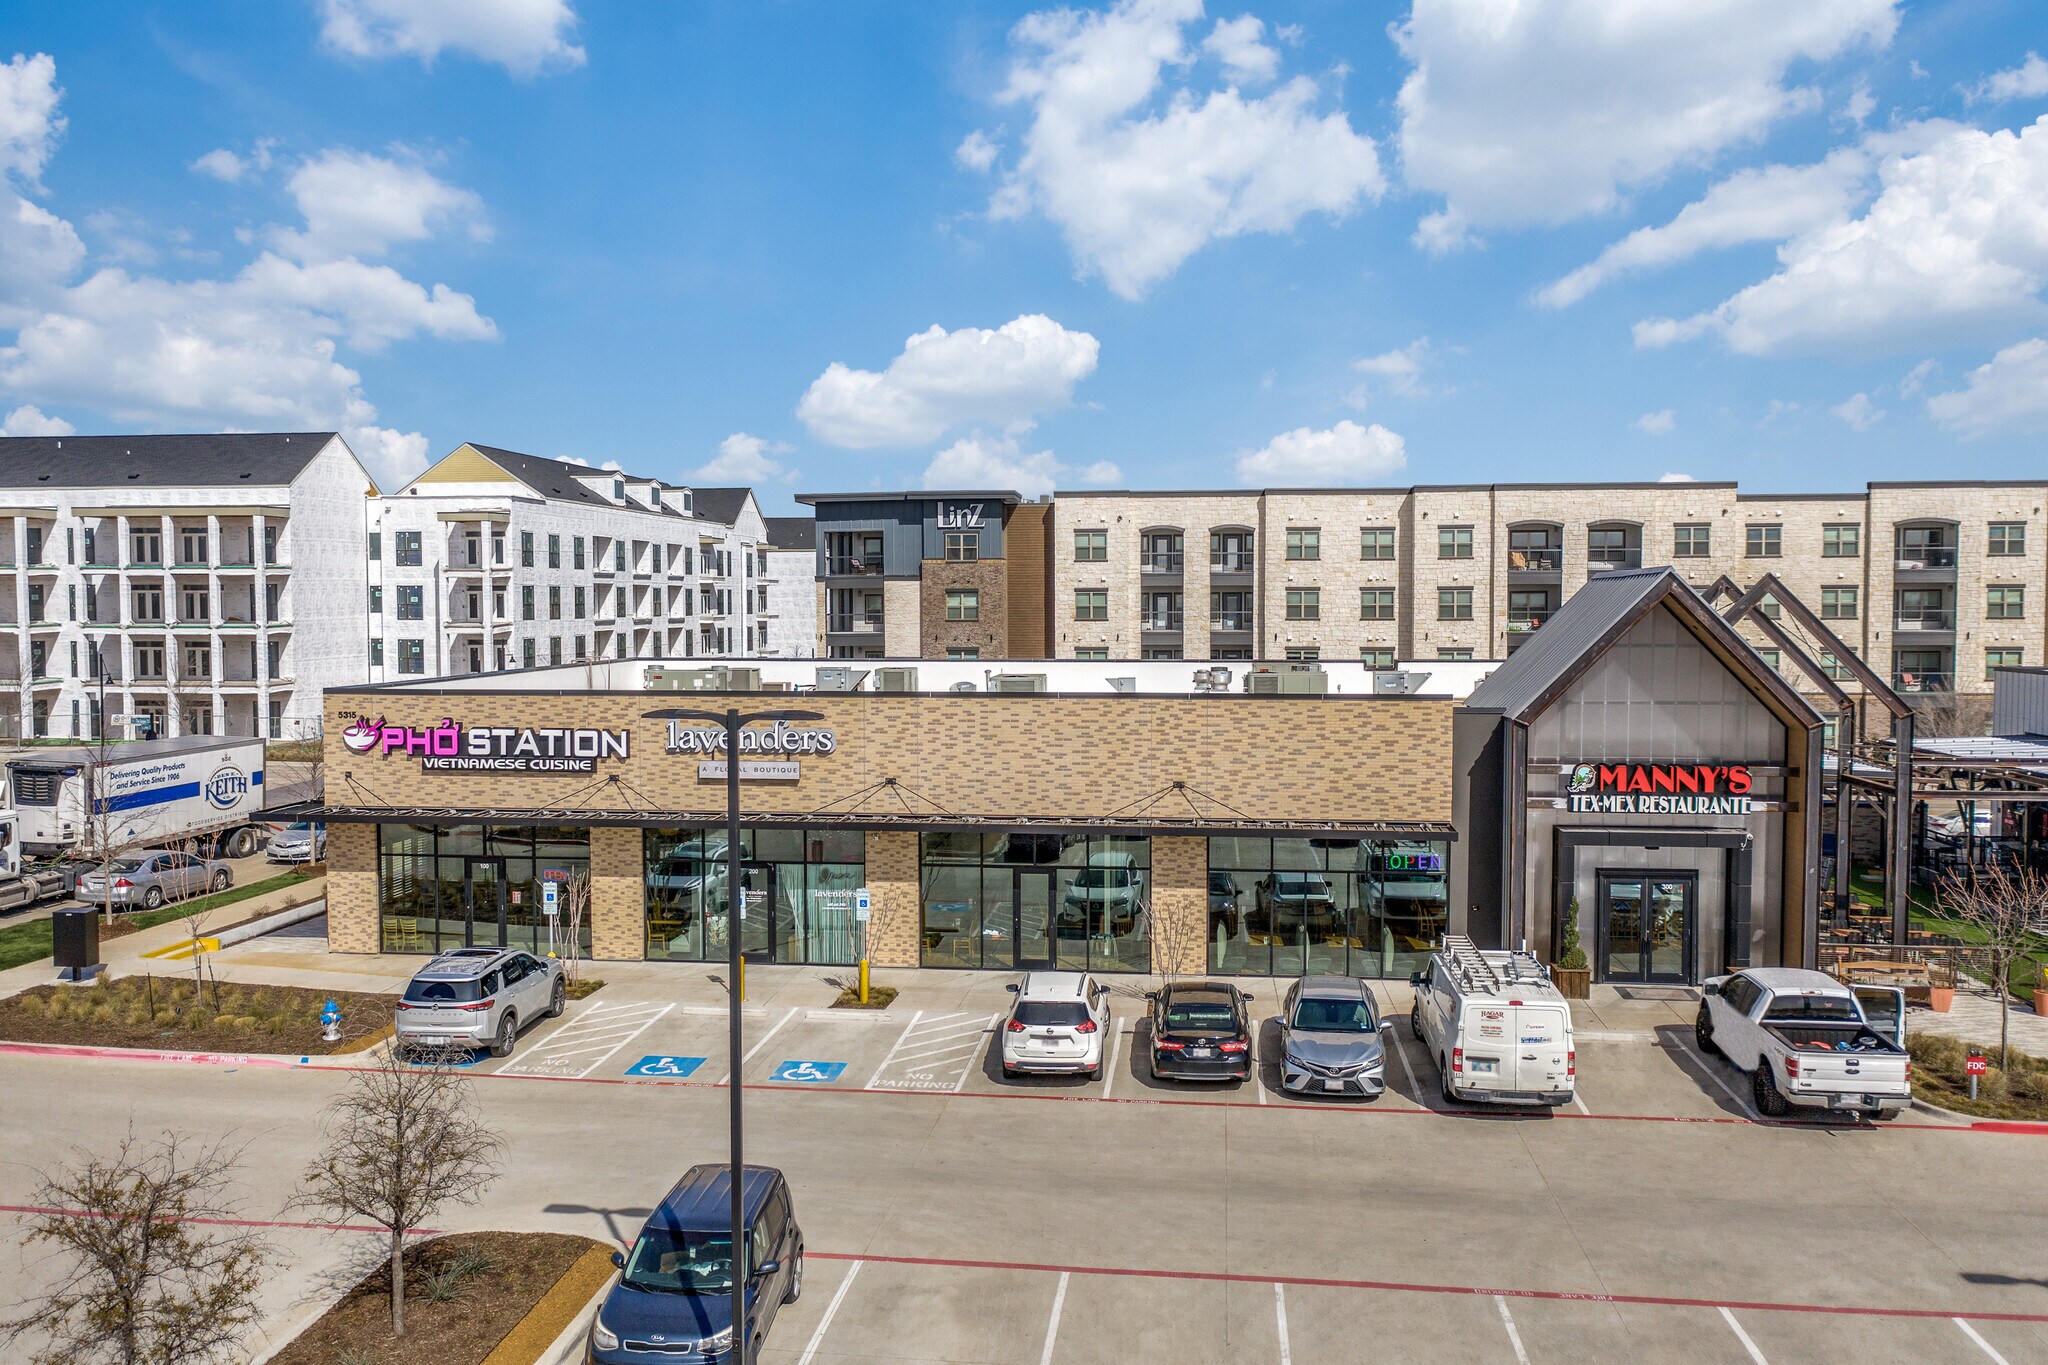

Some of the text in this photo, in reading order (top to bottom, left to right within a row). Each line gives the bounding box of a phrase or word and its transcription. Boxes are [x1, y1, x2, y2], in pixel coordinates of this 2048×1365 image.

[338, 711, 356, 719] 5315
[667, 720, 833, 750] lavenders
[468, 728, 628, 758] STATION
[110, 762, 186, 780] Delivering Quality Products
[423, 758, 592, 771] VIETNAMESE CUISINE
[116, 773, 180, 790] and Service Since 1906
[1599, 765, 1753, 793] MANNY'S
[205, 777, 247, 802] KEITH
[1571, 794, 1751, 814] TEX-MEX RESTAURANTE
[1390, 854, 1441, 869] OPEN
[543, 869, 567, 881] OPEN
[814, 888, 857, 898] lavenders
[160, 1053, 174, 1061] FIRE
[178, 1054, 194, 1062] LANE
[220, 1056, 249, 1065] PARKING
[1967, 1061, 1985, 1070] FDC
[505, 1065, 585, 1075] PARKING
[906, 1072, 934, 1080] NO
[874, 1080, 956, 1089] PARKING
